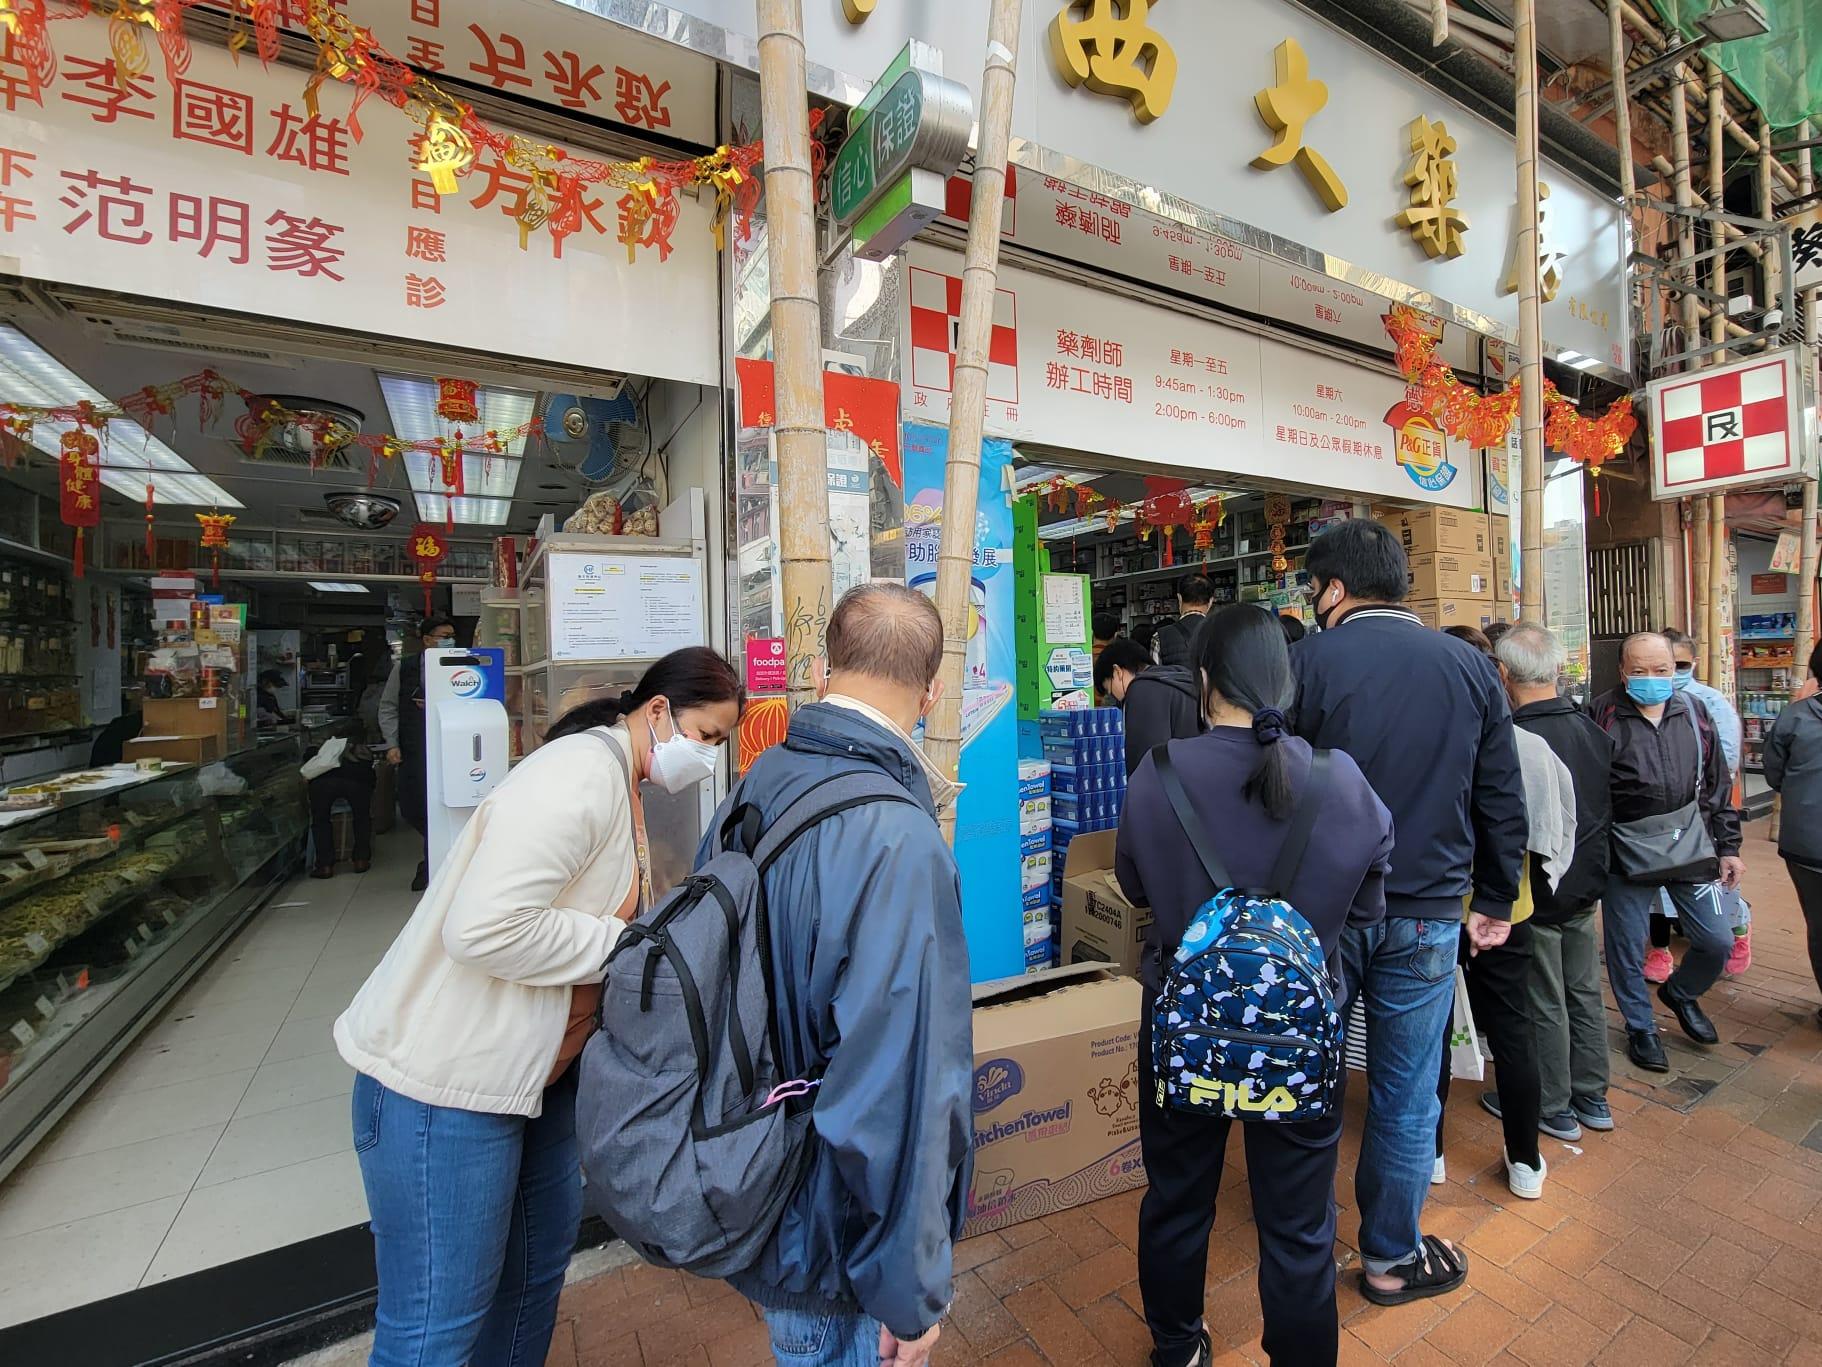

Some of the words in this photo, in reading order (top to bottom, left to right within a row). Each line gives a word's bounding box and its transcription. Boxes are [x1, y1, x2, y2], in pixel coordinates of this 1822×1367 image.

[61, 55, 350, 177] 李國雄
[837, 87, 917, 210] 信心保證
[58, 169, 346, 283] 范明篆
[1056, 328, 1123, 368] 藥劑師
[1169, 349, 1229, 375] 星期一至五
[1046, 361, 1133, 404] 辦工時間
[1155, 375, 1196, 395] 9:45am
[1208, 386, 1245, 404] 1:30pm
[1315, 383, 1344, 403] 星期六
[913, 391, 1018, 422] 政冊
[1155, 403, 1198, 422] 2:00pm
[1208, 411, 1246, 430] 6:00pm
[1292, 404, 1328, 422] 10:00am
[1335, 413, 1367, 431] 2:00pm
[451, 679, 480, 688] Walch
[1019, 780, 1045, 794] enTowel
[1021, 835, 1046, 849] enTowel
[1090, 1036, 1114, 1048] Product
[1116, 1033, 1132, 1045] Code:
[1091, 1046, 1114, 1059] Product
[978, 1081, 1012, 1102] Vinda
[1189, 1077, 1298, 1113] FILA
[972, 1102, 1070, 1149] itchenTowel
